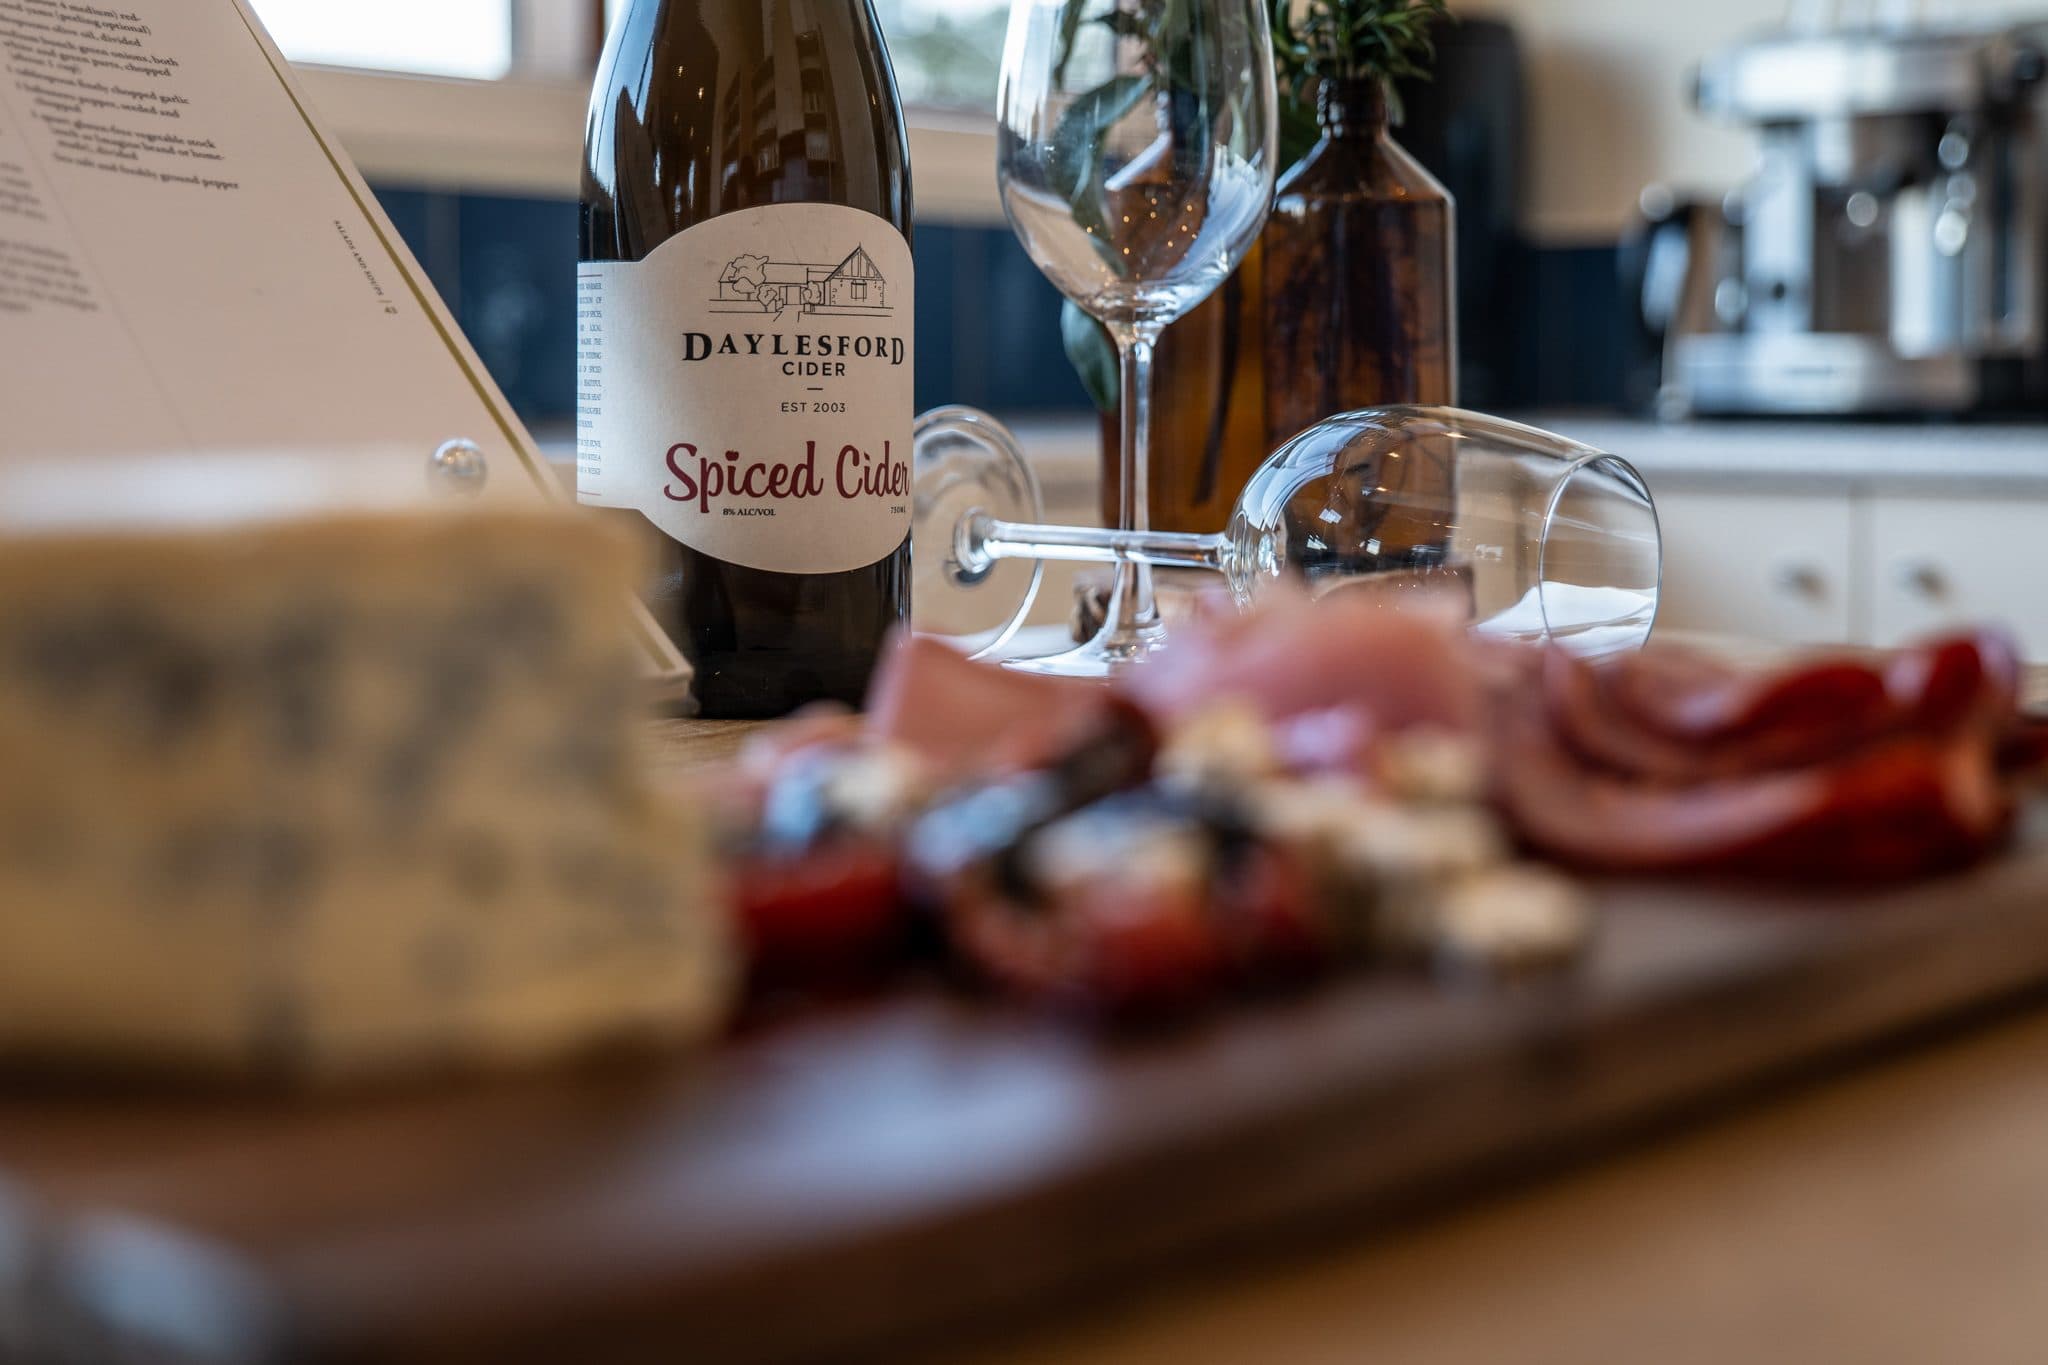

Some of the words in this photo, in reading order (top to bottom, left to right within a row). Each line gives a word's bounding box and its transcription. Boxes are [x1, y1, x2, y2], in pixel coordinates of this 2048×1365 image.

[102, 22, 151, 36] optional)
[159, 95, 190, 105] garlic
[201, 178, 239, 191] pepper
[682, 332, 905, 366] DAYLESFORD
[782, 361, 846, 377] CIDER
[781, 402, 807, 413] EST
[814, 402, 846, 413] 2003
[664, 440, 824, 514] Spiced
[836, 440, 910, 499] Cider
[723, 508, 736, 516] 8%
[737, 508, 776, 517] ALC/VOL
